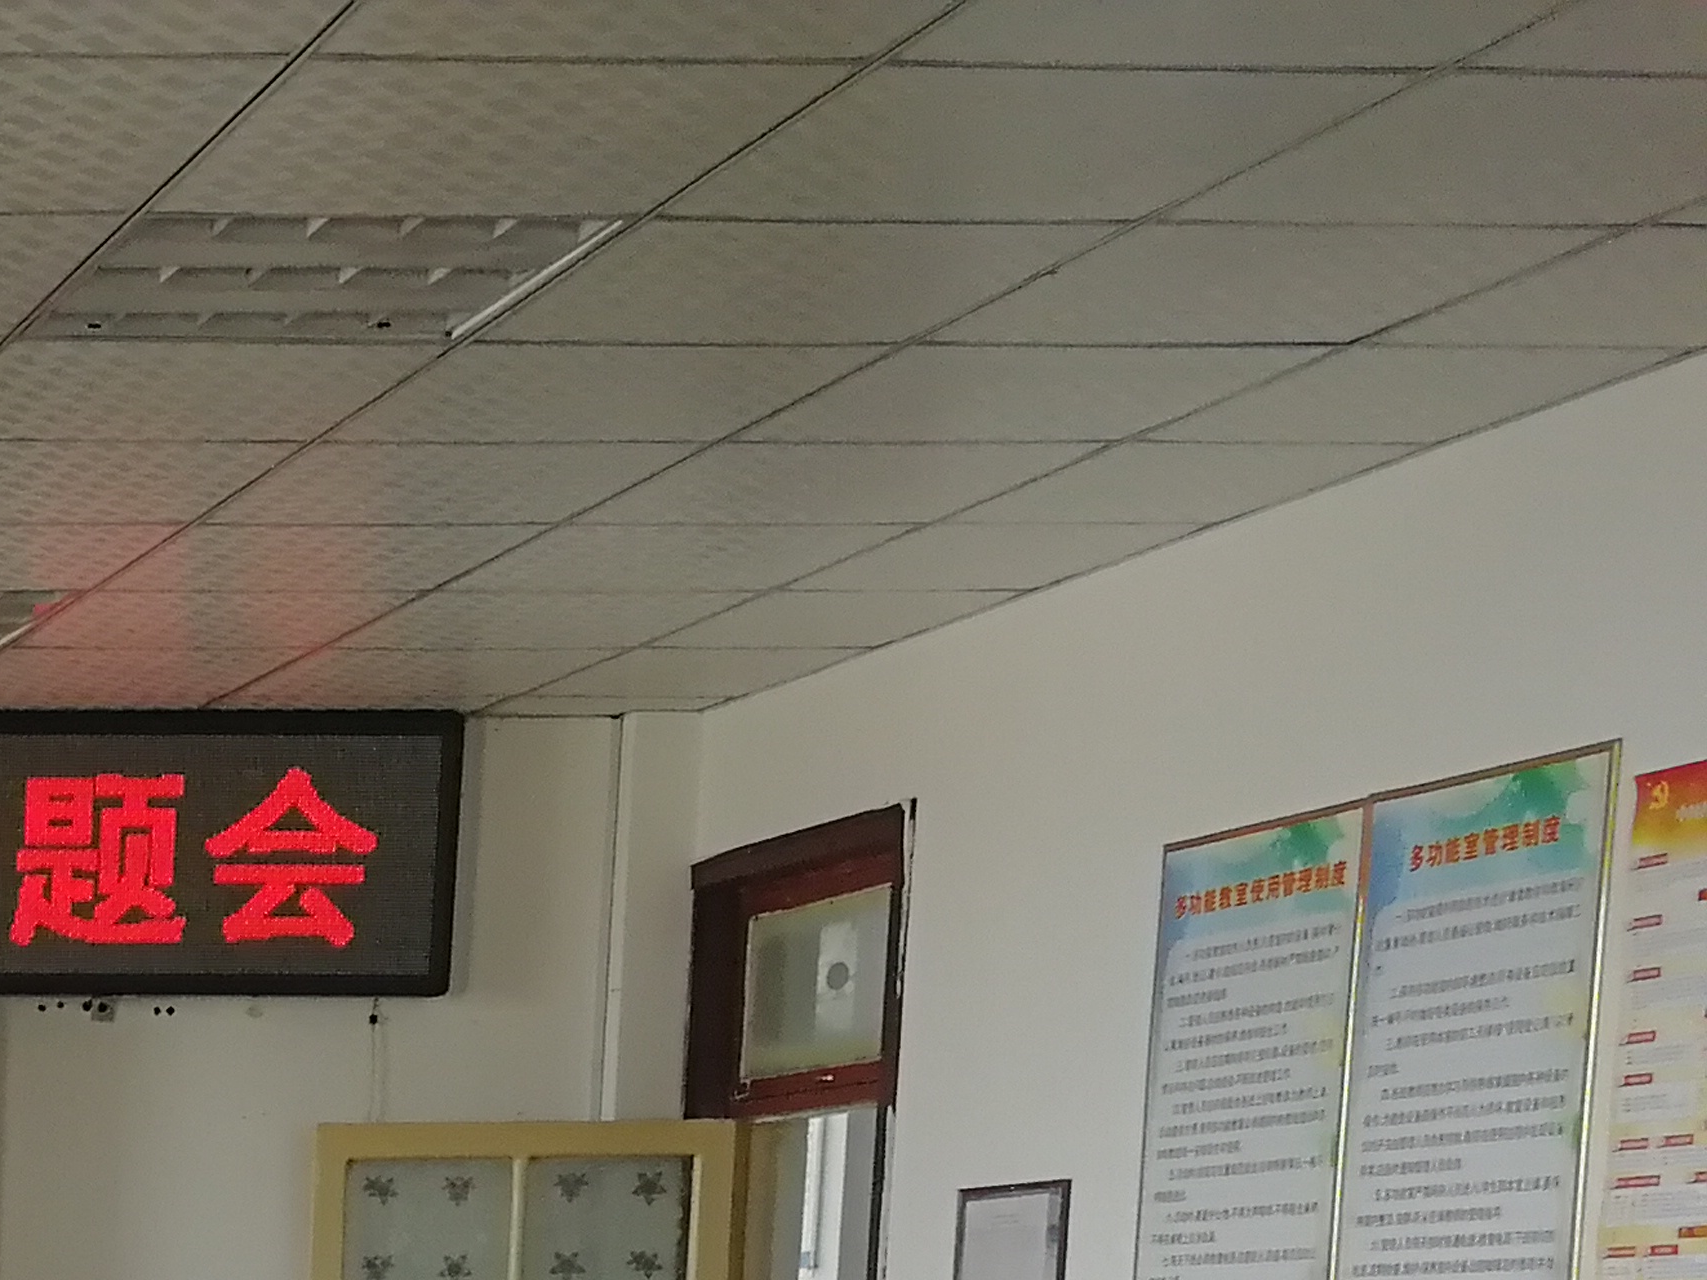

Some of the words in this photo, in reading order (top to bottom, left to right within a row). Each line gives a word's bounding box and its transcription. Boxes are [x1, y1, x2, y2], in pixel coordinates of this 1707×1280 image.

[1409, 815, 1560, 872] 多功能室管理制度
[1174, 861, 1347, 919] 多功能教室使用管理制度
